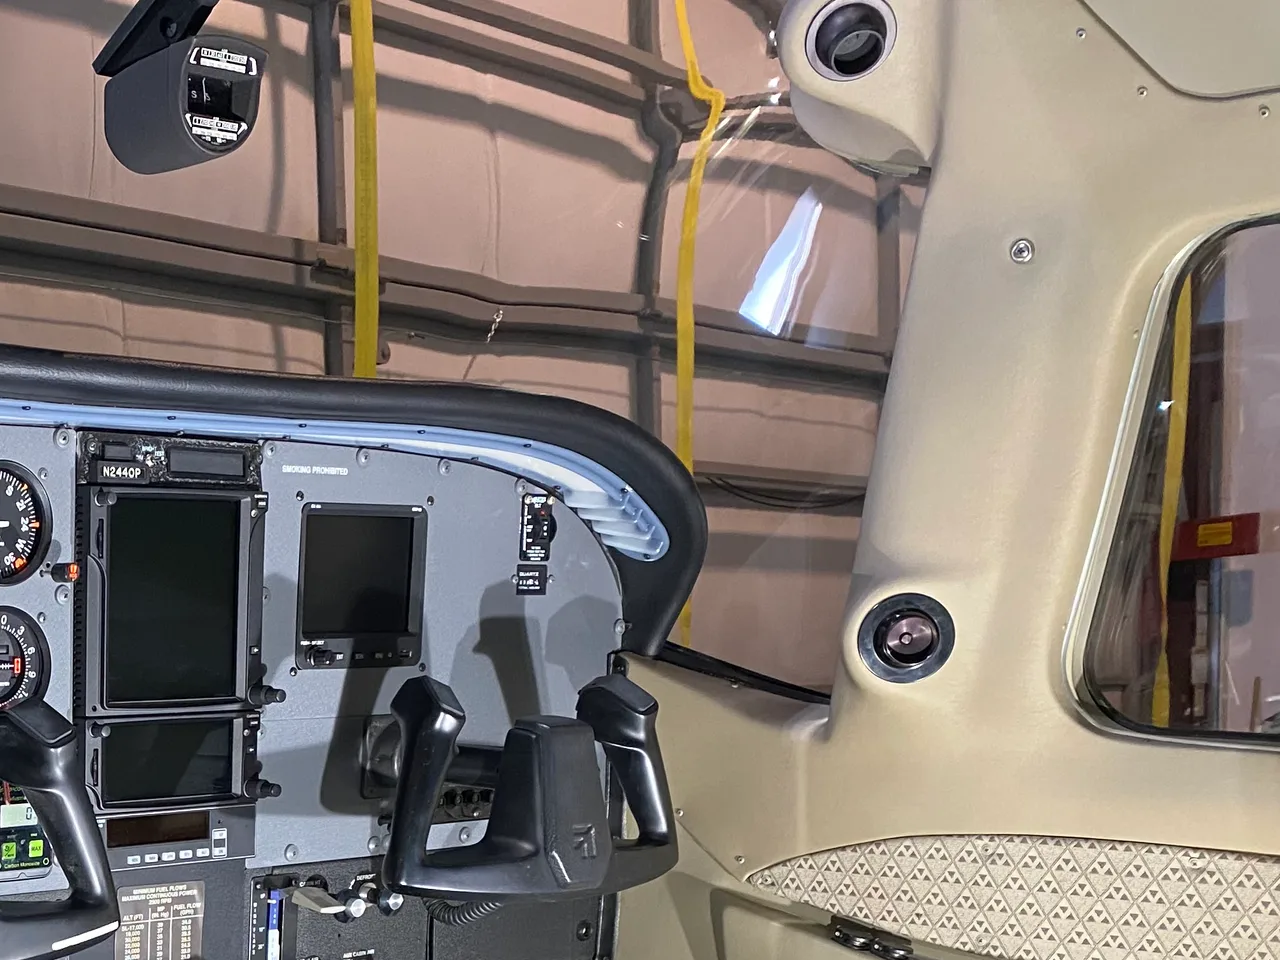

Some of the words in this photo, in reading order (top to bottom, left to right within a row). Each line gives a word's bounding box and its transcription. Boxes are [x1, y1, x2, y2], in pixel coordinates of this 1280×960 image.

[103, 466, 141, 479] N2440P
[282, 465, 311, 474] SMOKING
[312, 465, 348, 476] PROHIBITED
[20, 516, 29, 532] 24
[15, 538, 26, 552] W
[1, 615, 7, 624] 0
[17, 626, 25, 635] 3
[28, 646, 35, 654] 6
[28, 670, 36, 678] 9
[26, 806, 32, 820] 0
[133, 887, 156, 895] MINIMUM
[146, 891, 178, 900] CONTINUOUS
